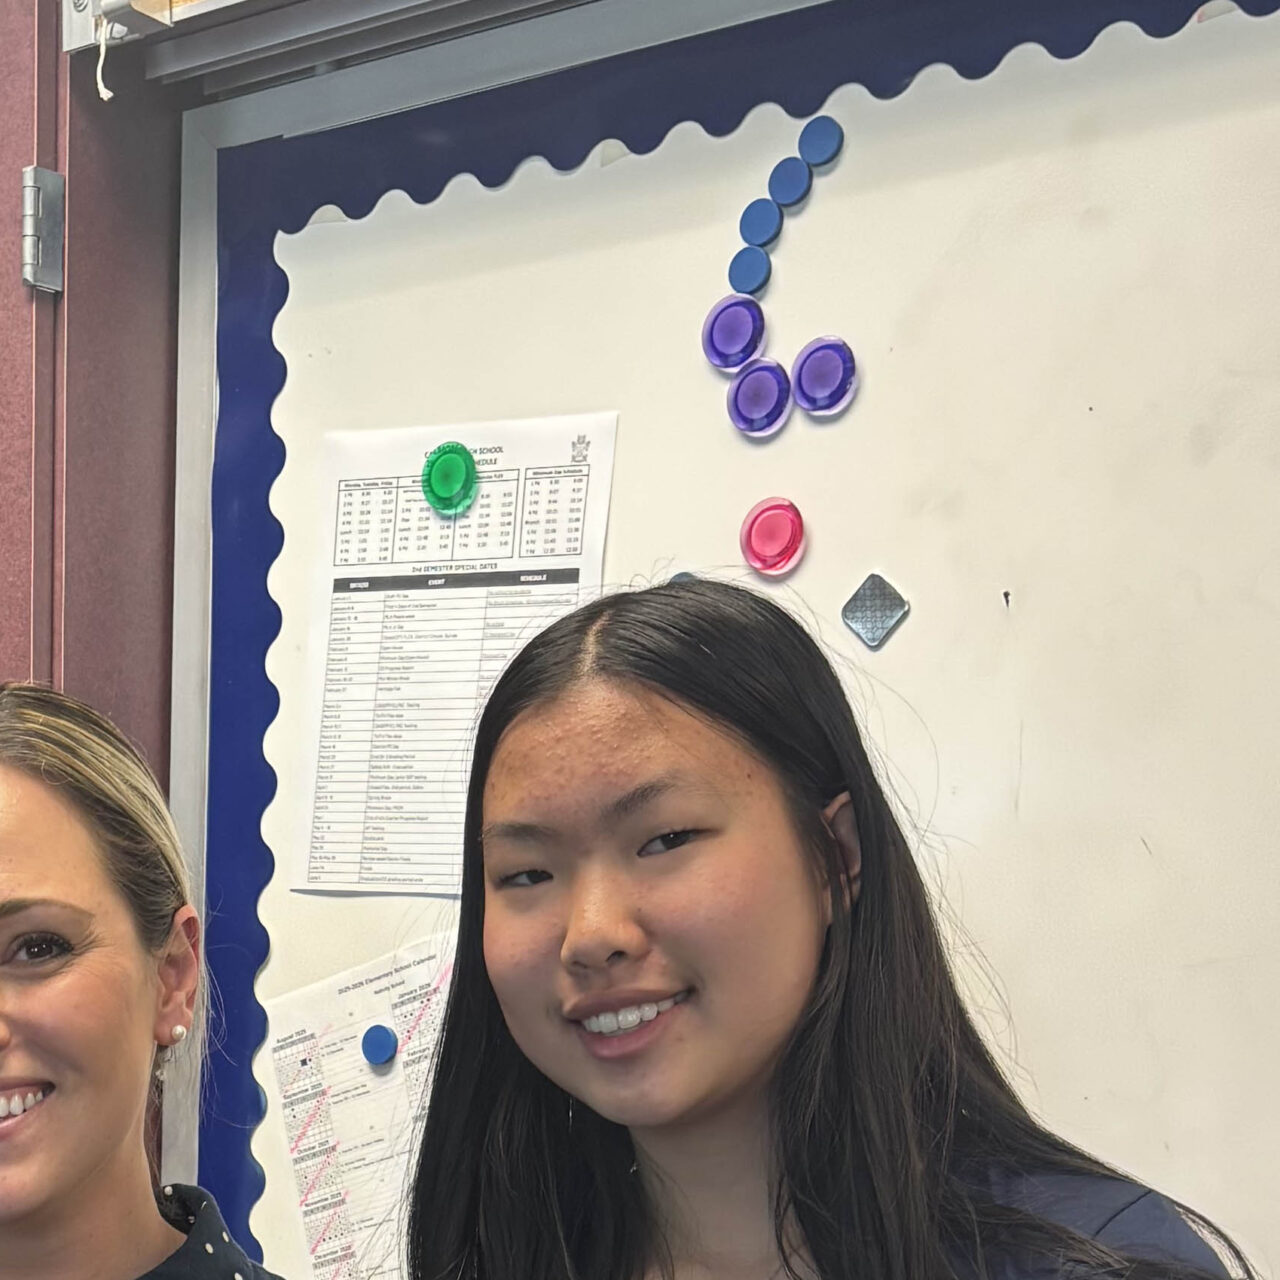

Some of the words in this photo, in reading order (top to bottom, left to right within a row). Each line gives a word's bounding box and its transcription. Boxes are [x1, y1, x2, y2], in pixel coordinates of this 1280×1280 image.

[478, 446, 504, 455] SCHOOL
[423, 564, 453, 572] SEMESTER
[365, 971, 393, 985] Elementary
[394, 963, 412, 974] School
[412, 954, 436, 966] Calendar
[283, 1088, 309, 1100] September
[304, 1197, 329, 1207] November
[314, 1250, 338, 1261] December
